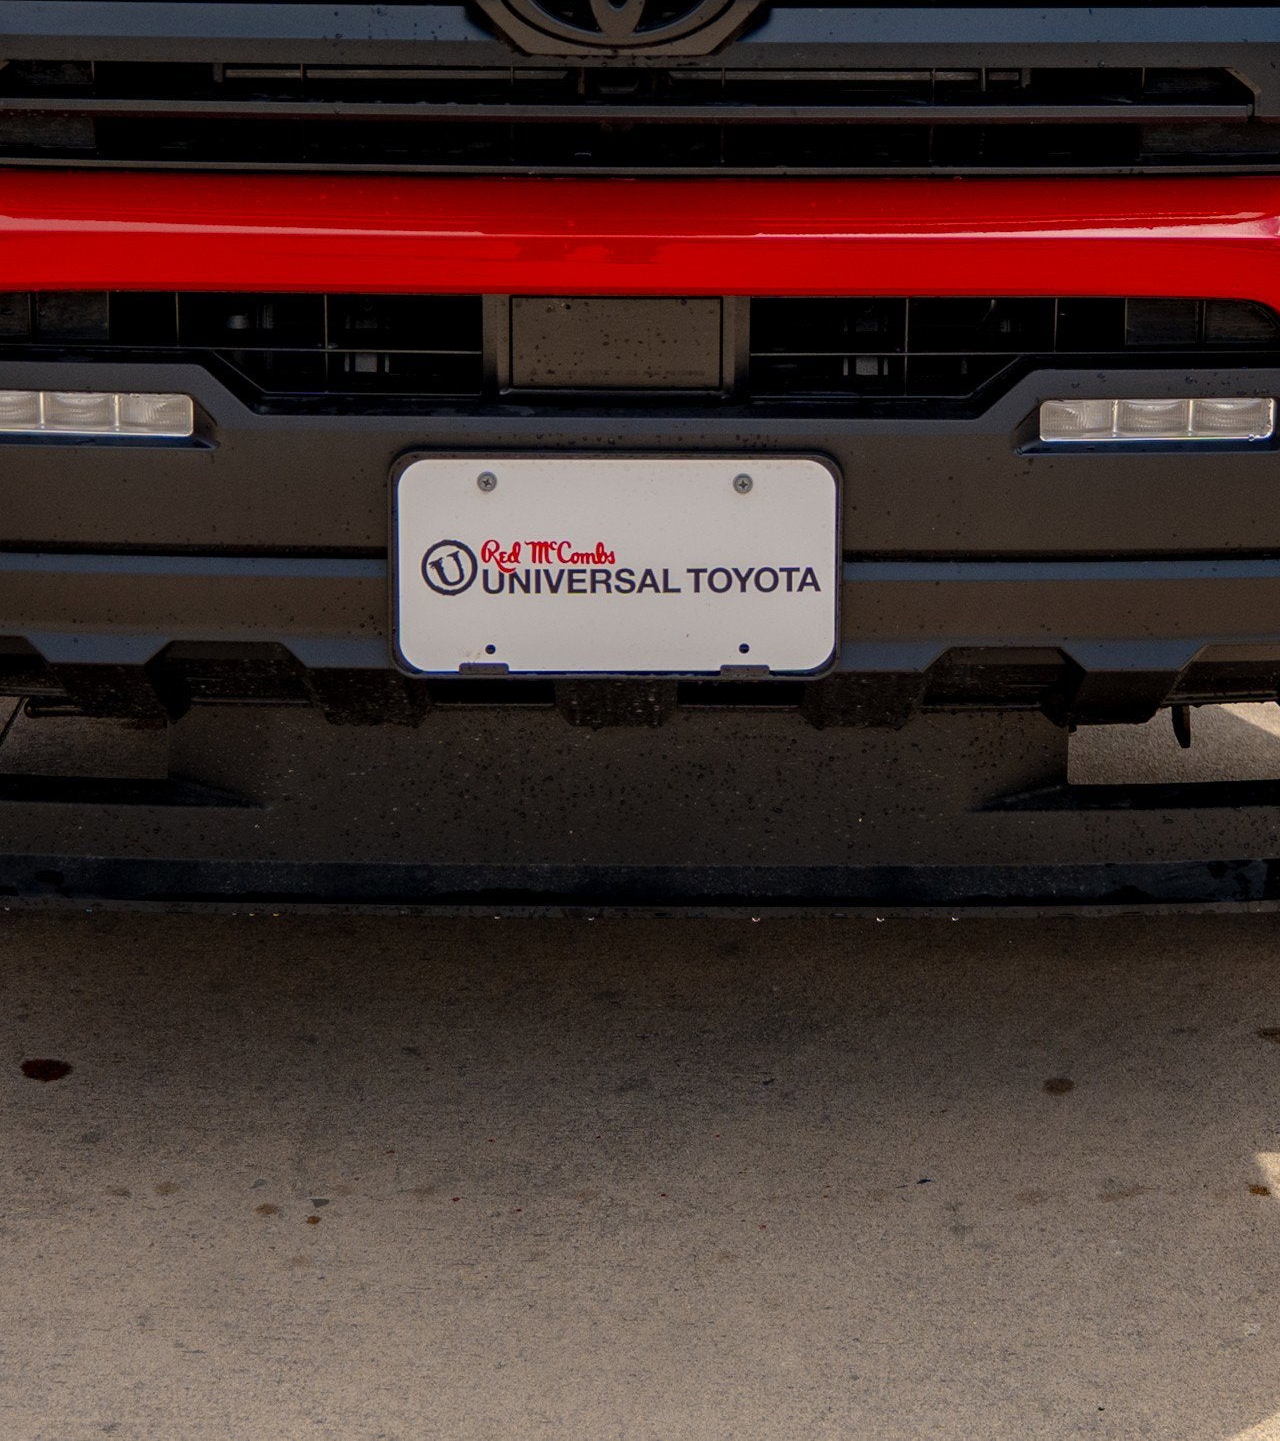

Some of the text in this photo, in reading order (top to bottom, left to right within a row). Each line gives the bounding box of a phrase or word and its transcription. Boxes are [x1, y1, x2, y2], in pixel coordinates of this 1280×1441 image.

[481, 539, 616, 574] Red McCombs
[482, 566, 822, 595] UNIVERSAL TOYOTA
